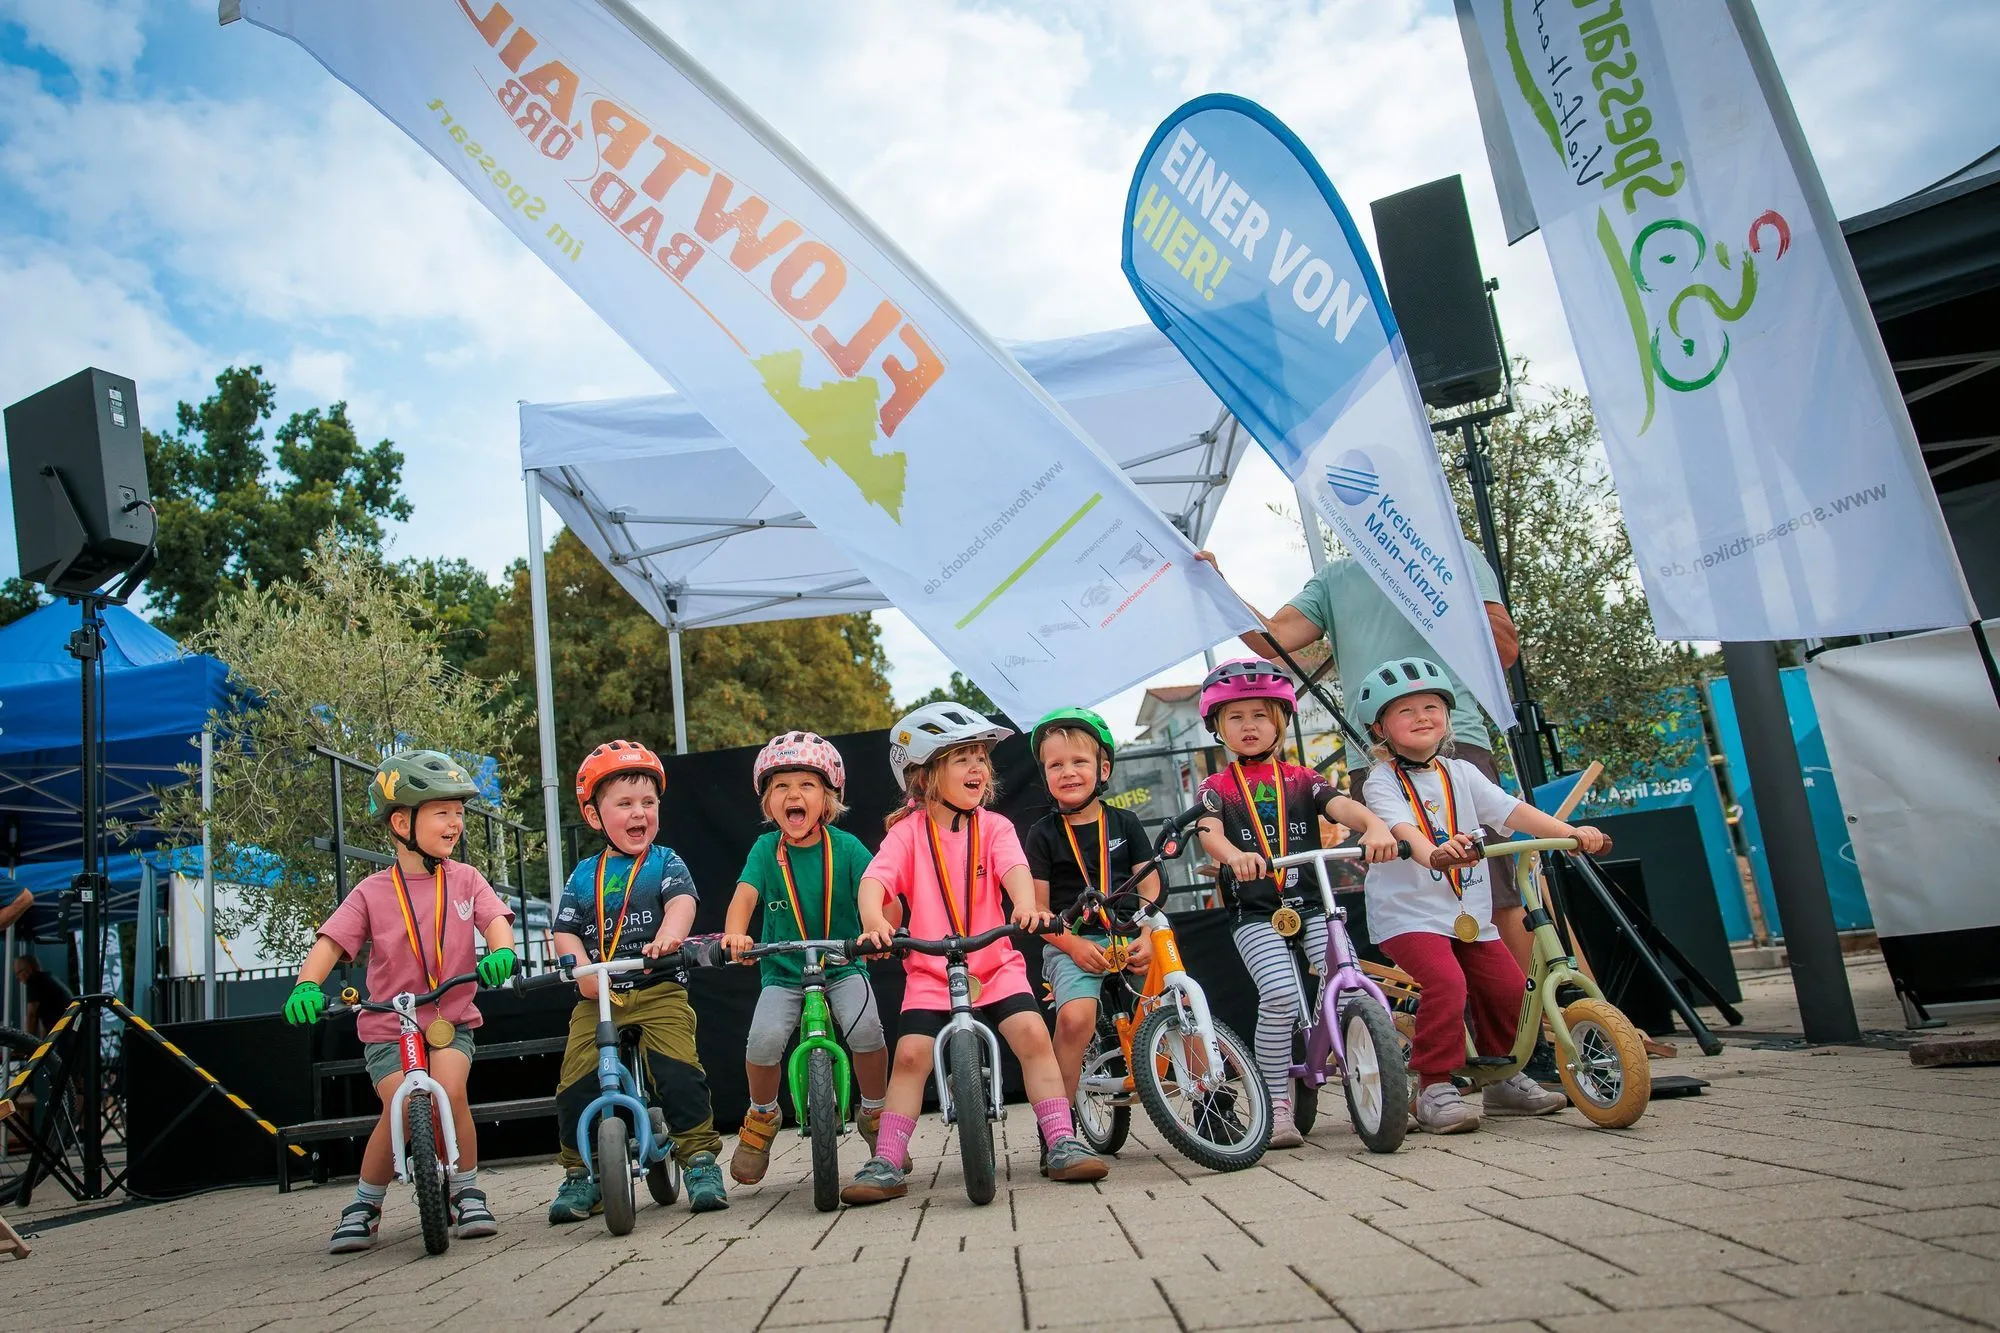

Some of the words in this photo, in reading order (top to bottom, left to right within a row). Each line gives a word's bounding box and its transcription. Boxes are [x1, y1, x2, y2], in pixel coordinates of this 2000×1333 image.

[1133, 184, 1232, 301] HIER!
[1160, 127, 1270, 262] EINER
[1268, 229, 1369, 344] VON
[1317, 494, 1434, 632] www.einervonhier-kreiswerke.de
[1364, 512, 1449, 618] Main-Kinzig
[1377, 494, 1453, 586] Kreiswerke
[406, 1033, 417, 1069] woom
